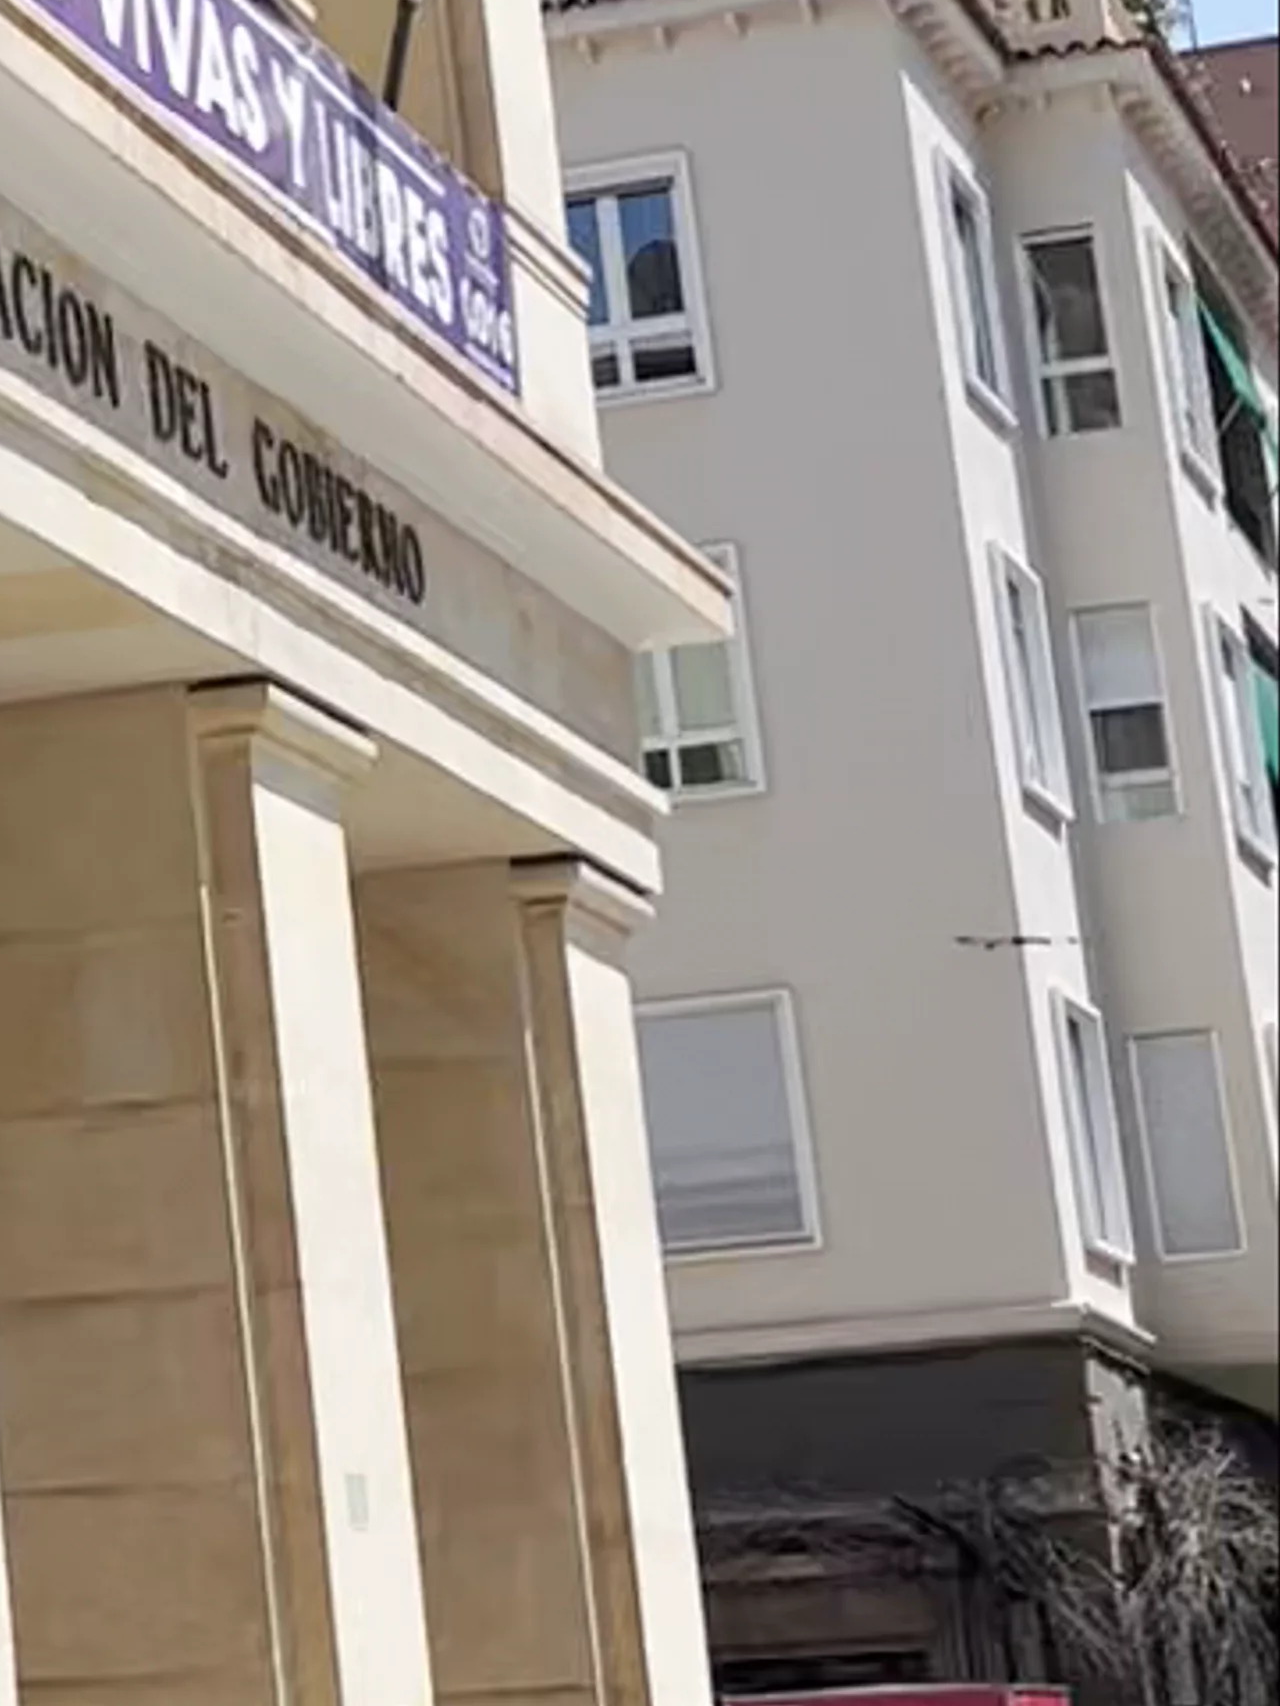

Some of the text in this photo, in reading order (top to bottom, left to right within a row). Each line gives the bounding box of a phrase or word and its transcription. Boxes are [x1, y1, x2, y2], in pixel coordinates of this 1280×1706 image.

[272, 58, 308, 188] Y
[315, 101, 454, 325] LIBRES
[144, 339, 230, 480] DEL
[252, 415, 427, 606] GOBIERNO
